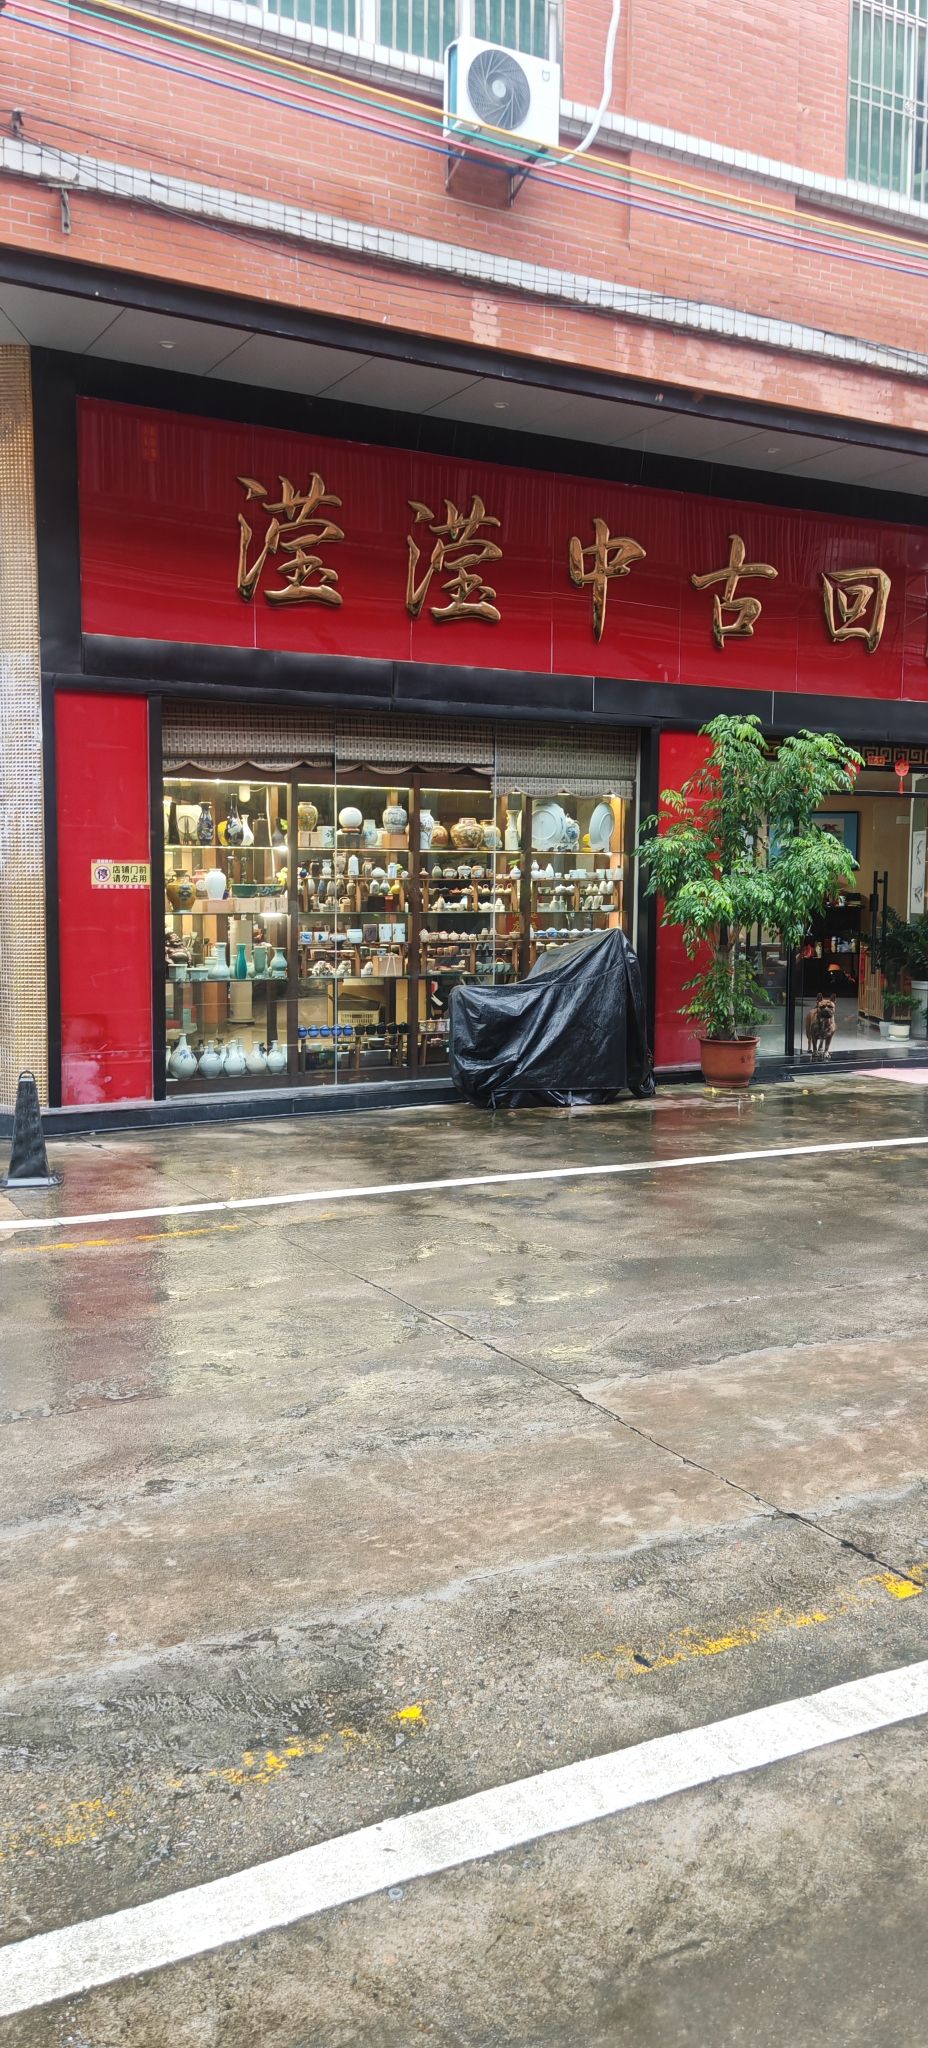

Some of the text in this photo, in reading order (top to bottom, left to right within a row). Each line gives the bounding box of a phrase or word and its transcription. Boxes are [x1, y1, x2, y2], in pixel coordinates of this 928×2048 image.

[237, 472, 892, 655] 滢滢中古回
[112, 865, 147, 874] 店铺门前
[112, 874, 147, 883] 请勿占用
